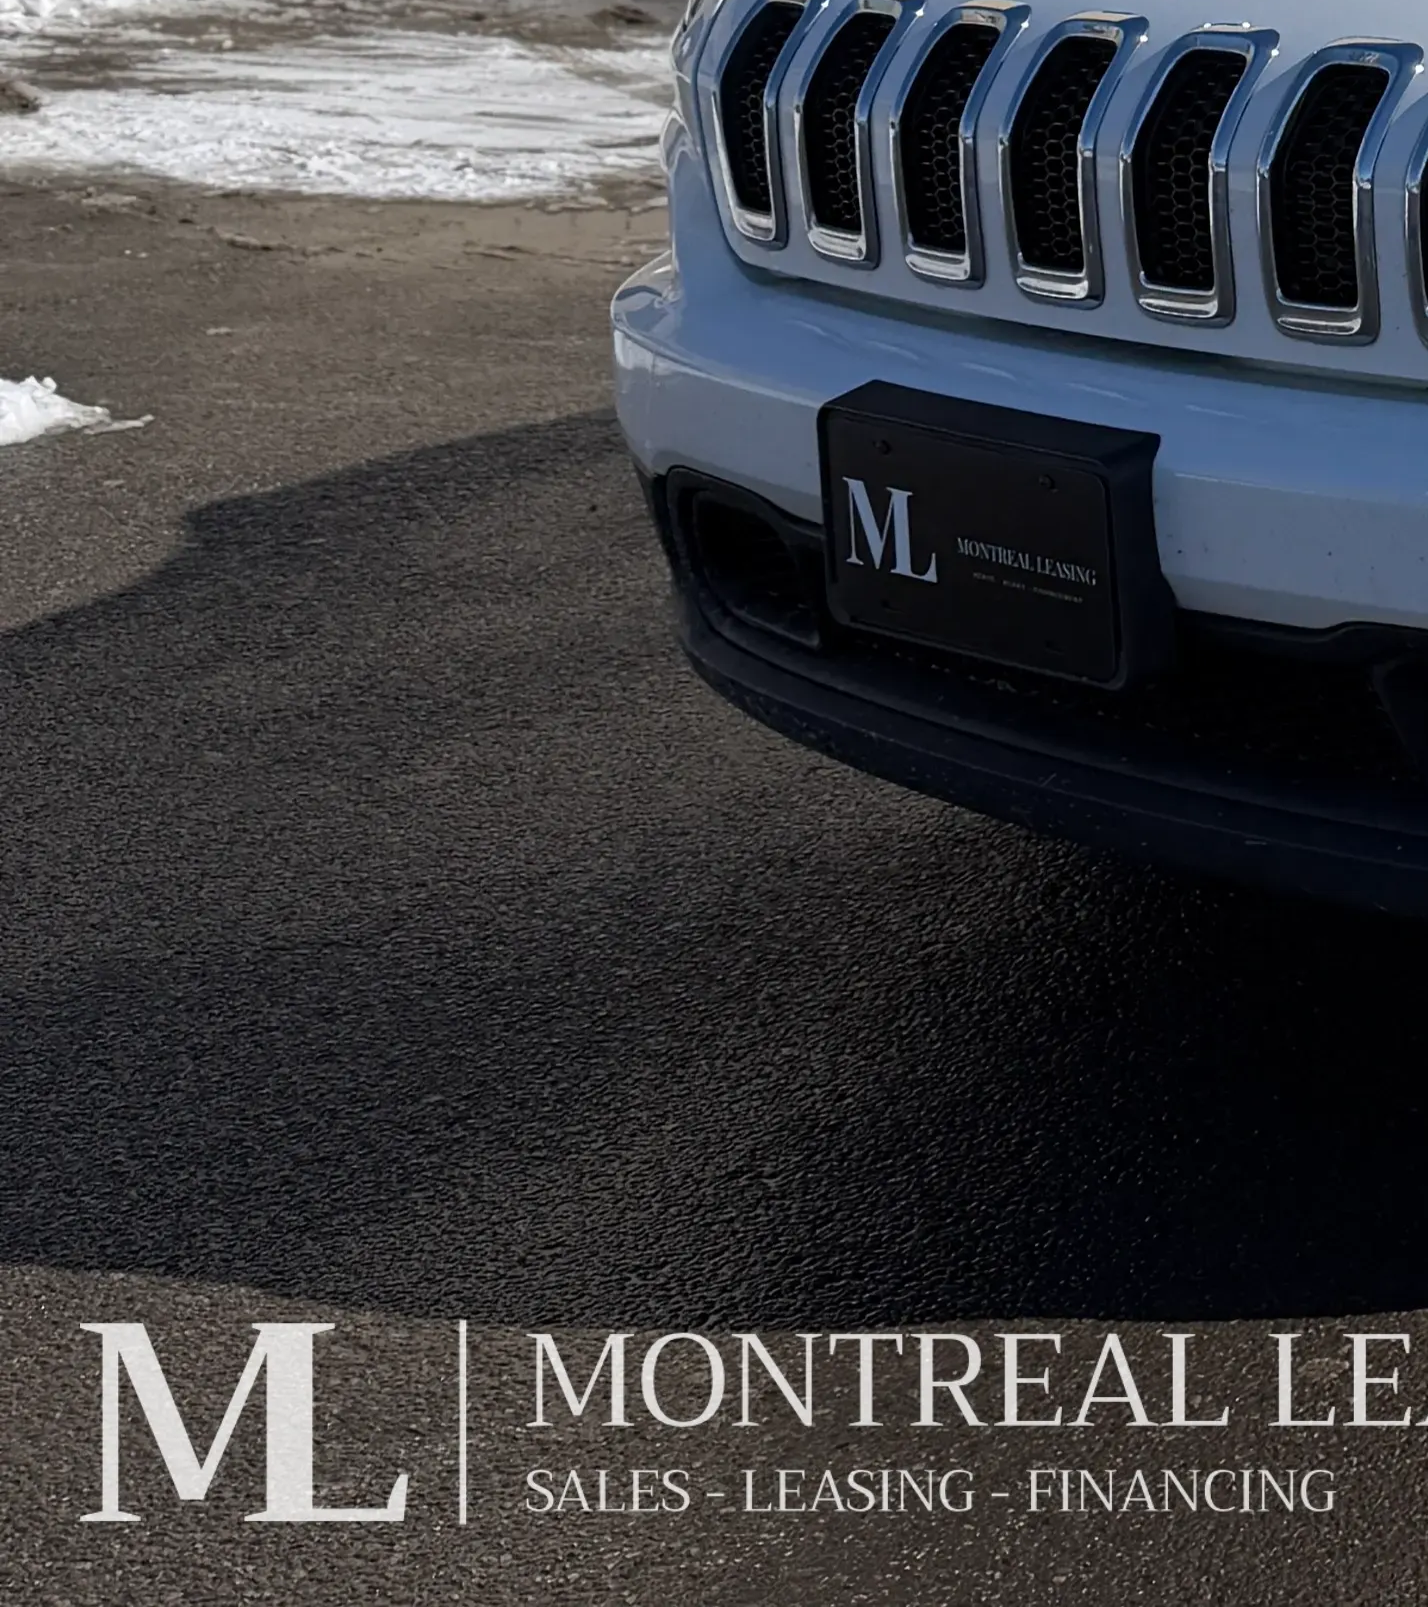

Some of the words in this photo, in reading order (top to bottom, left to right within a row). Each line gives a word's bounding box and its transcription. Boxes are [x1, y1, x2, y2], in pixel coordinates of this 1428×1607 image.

[842, 476, 938, 584] ML
[957, 537, 1035, 572] MONTREAL
[1037, 556, 1097, 586] LEASING
